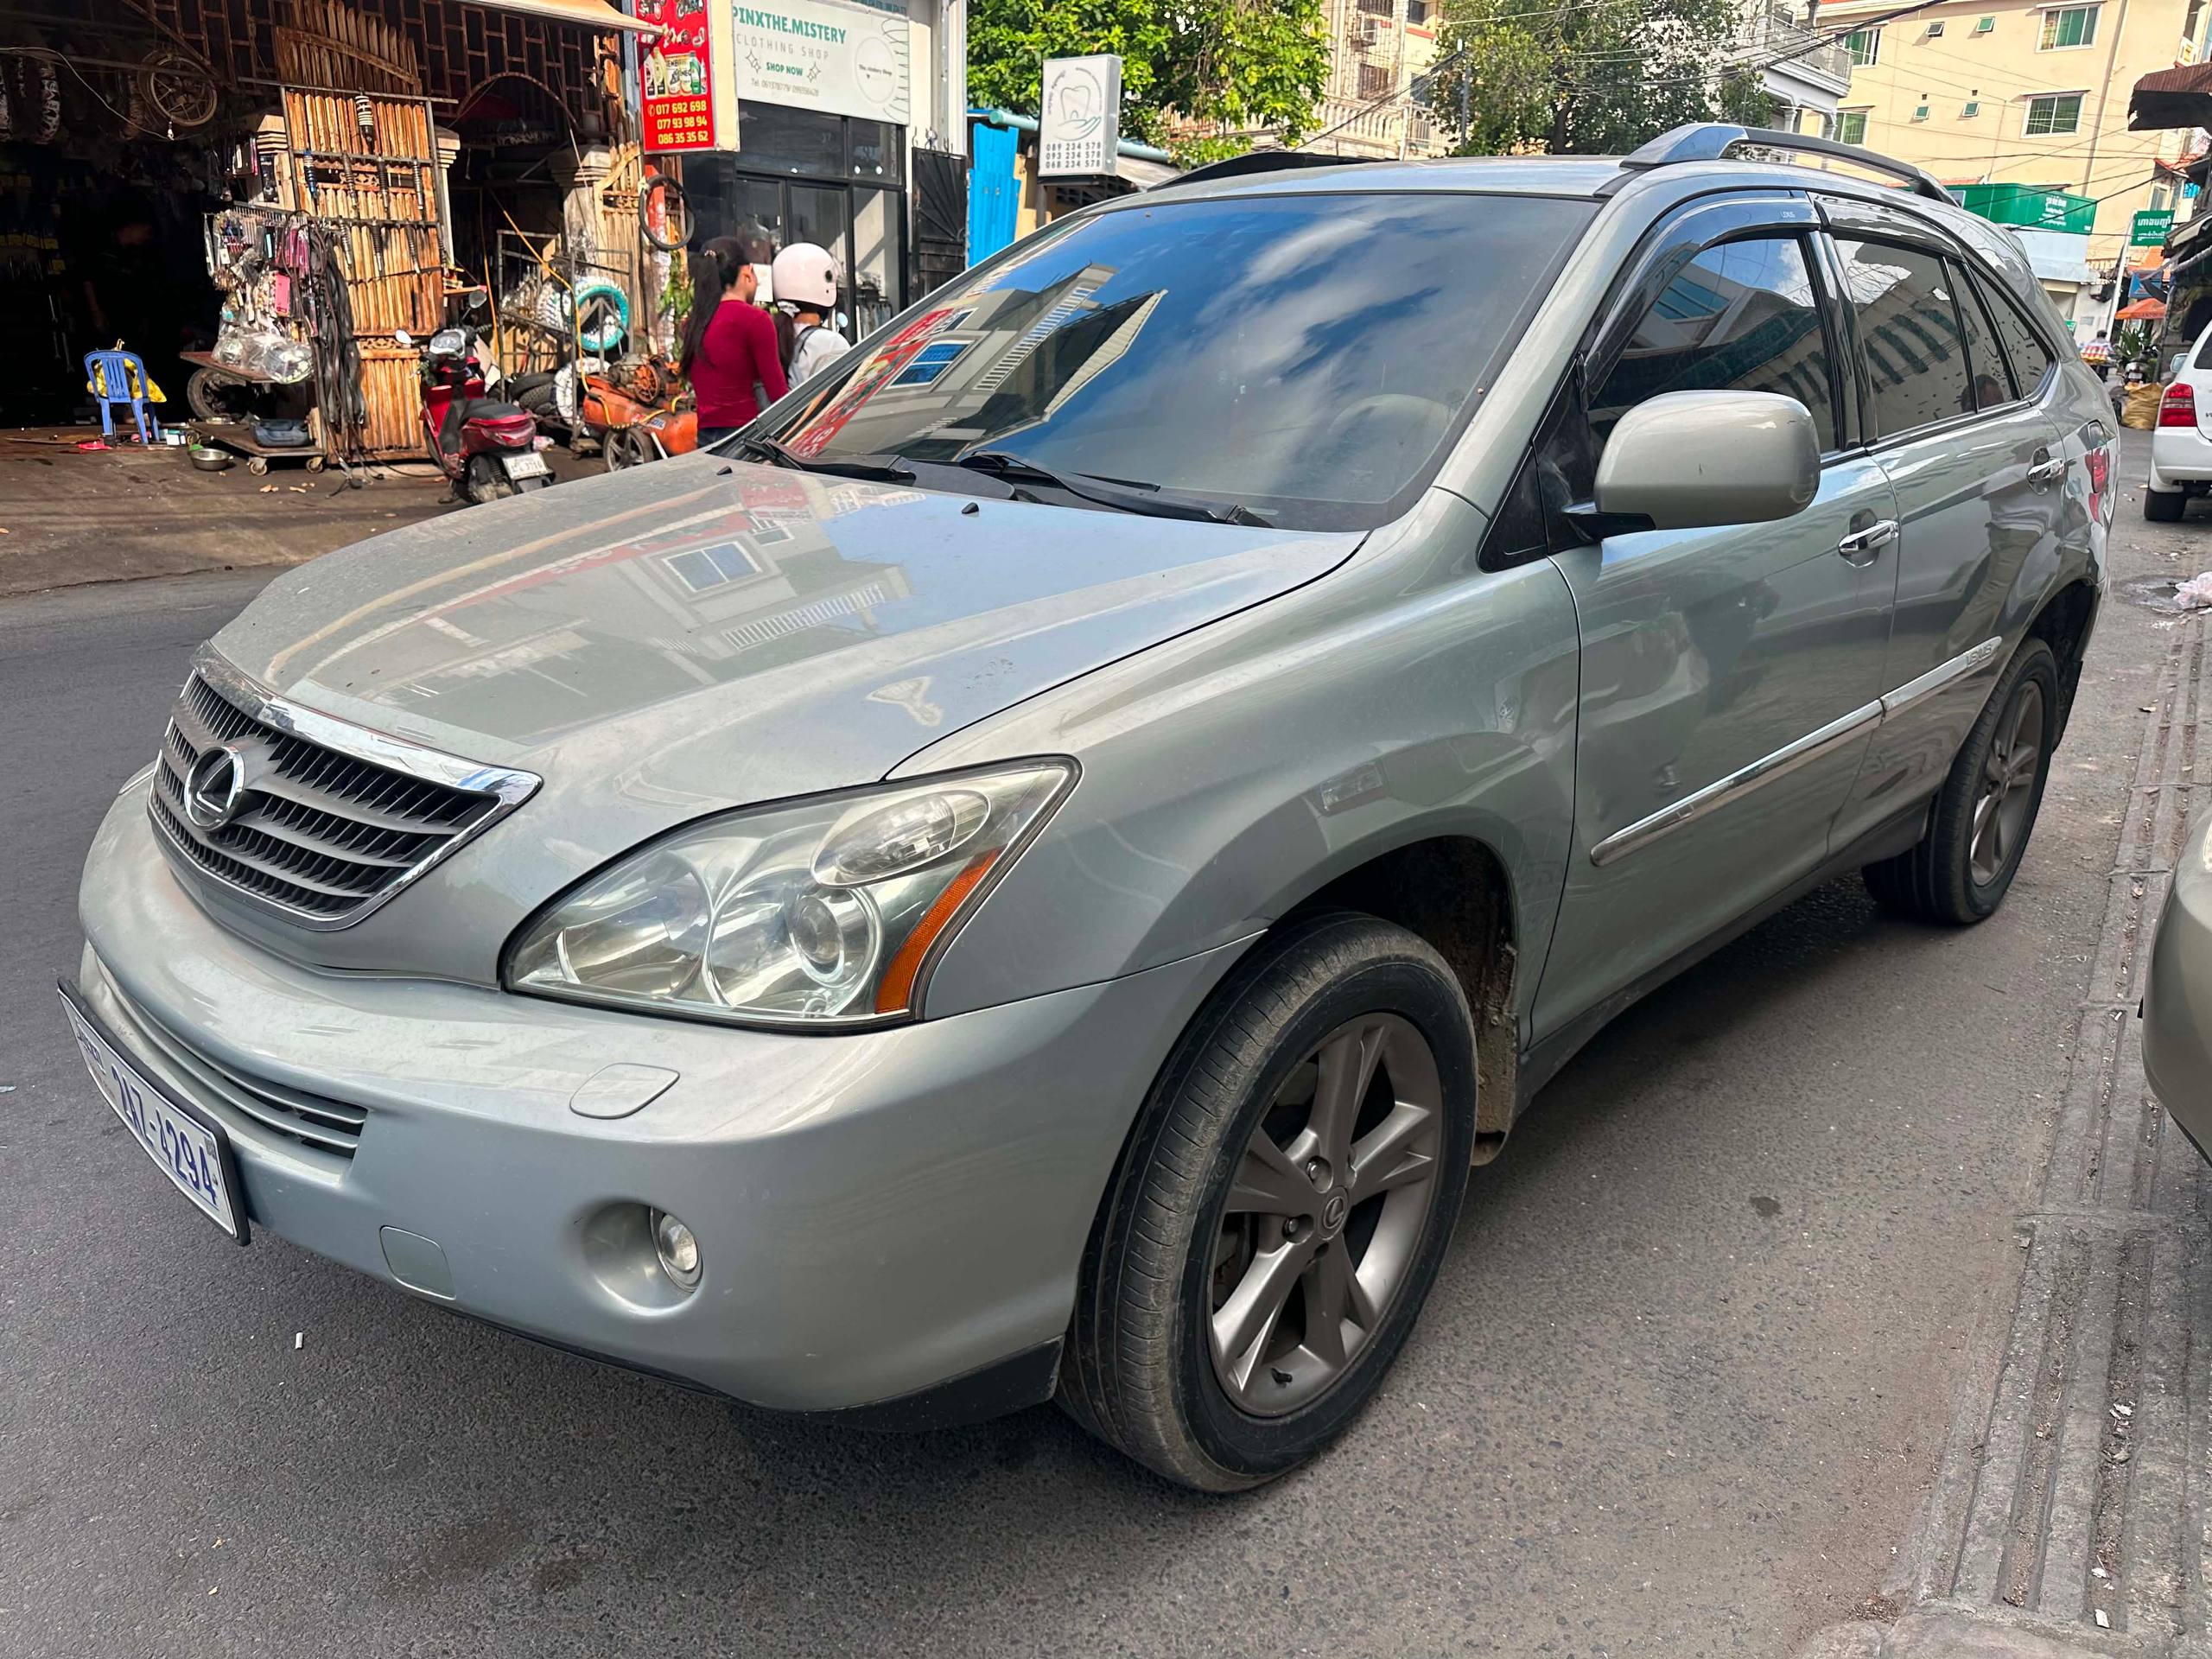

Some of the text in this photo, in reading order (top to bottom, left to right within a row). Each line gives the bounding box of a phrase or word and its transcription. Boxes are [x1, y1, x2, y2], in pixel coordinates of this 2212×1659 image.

[736, 34, 830, 60] CLOTHING SHOP
[766, 62, 804, 76] SHOP NOW
[656, 100, 707, 115] 017 692 698
[657, 116, 708, 130] 077 93 98 94
[658, 130, 709, 144] 086 35 35 62
[1085, 142, 1102, 150] 578
[1046, 150, 1101, 161] 093 234 578
[1084, 159, 1101, 168] 578
[111, 1064, 218, 1205] 2AZ-4294
